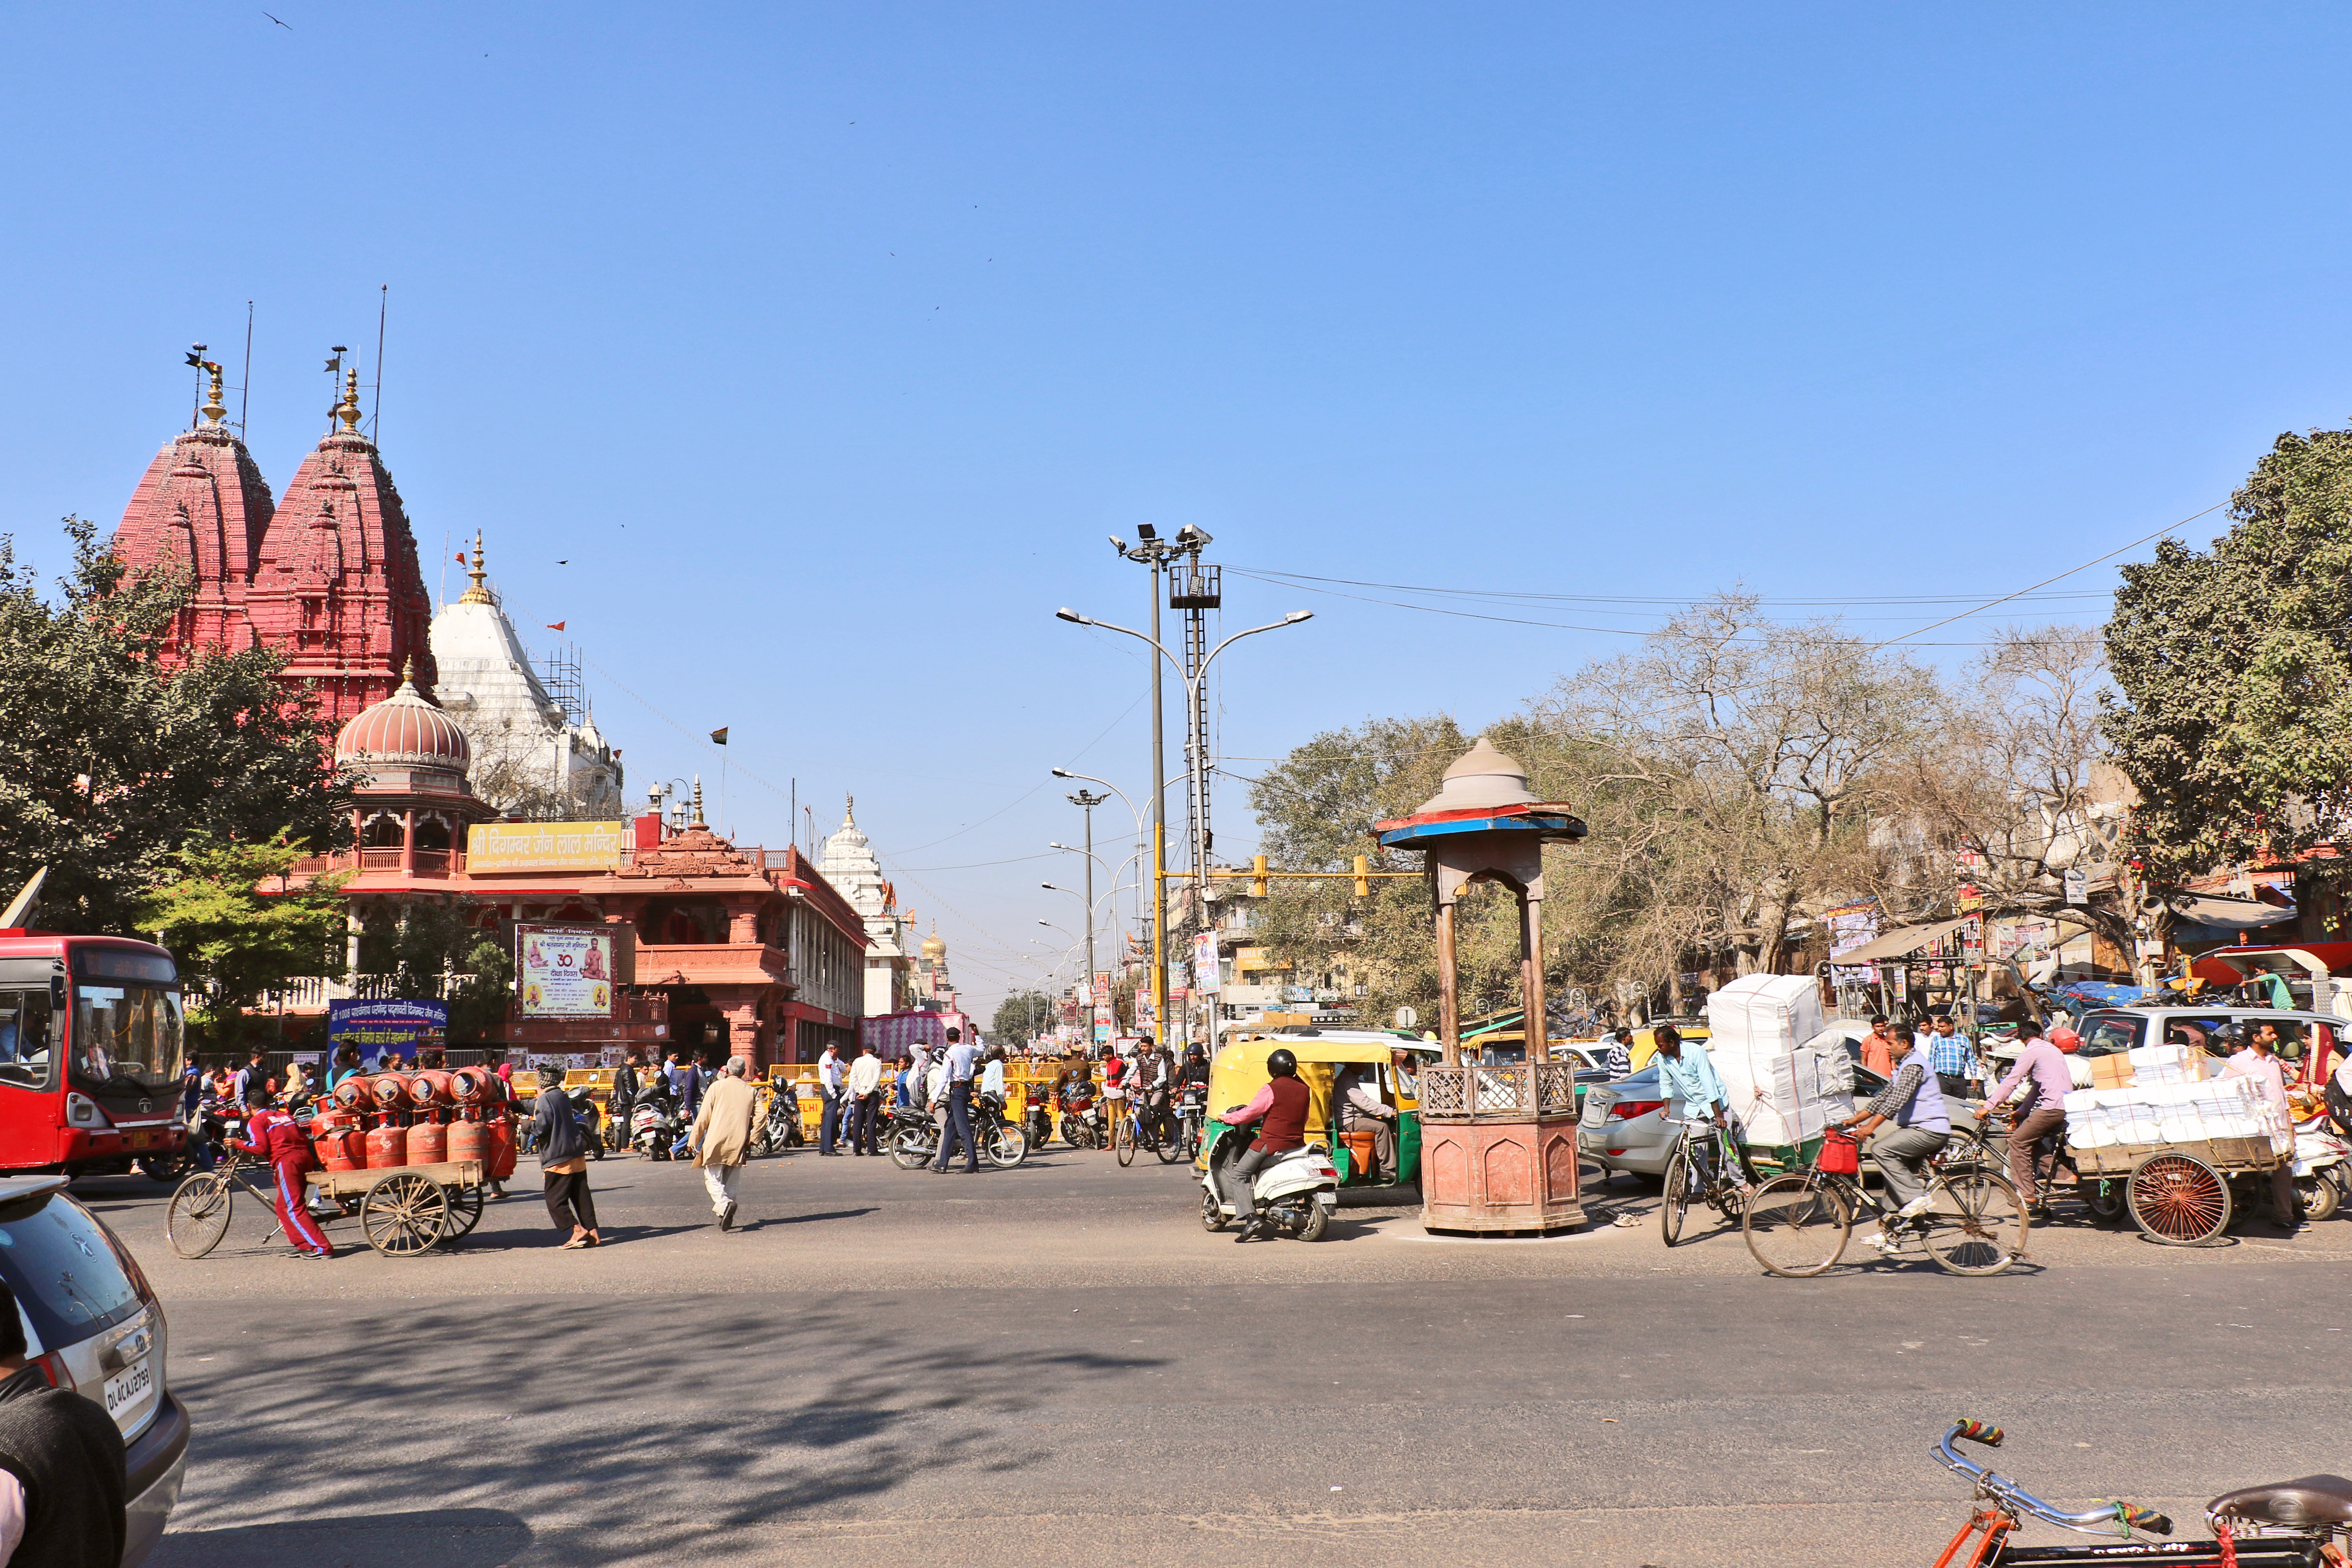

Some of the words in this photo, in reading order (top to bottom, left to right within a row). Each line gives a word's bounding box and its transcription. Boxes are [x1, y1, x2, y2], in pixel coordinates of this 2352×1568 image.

[471, 827, 486, 855] श्री
[488, 827, 531, 855] दिगम्बर
[533, 826, 554, 854] जैन
[557, 833, 582, 854] लाल
[584, 825, 619, 853] मन्दिर
[539, 857, 557, 867] दिगम्बर
[558, 857, 568, 866] जैन
[604, 856, 618, 866] दिल्ली
[1239, 949, 1256, 959] RANA
[557, 954, 573, 967] 30
[564, 969, 578, 977] दिवस
[108, 1367, 150, 1410] DL4CAJ2793
